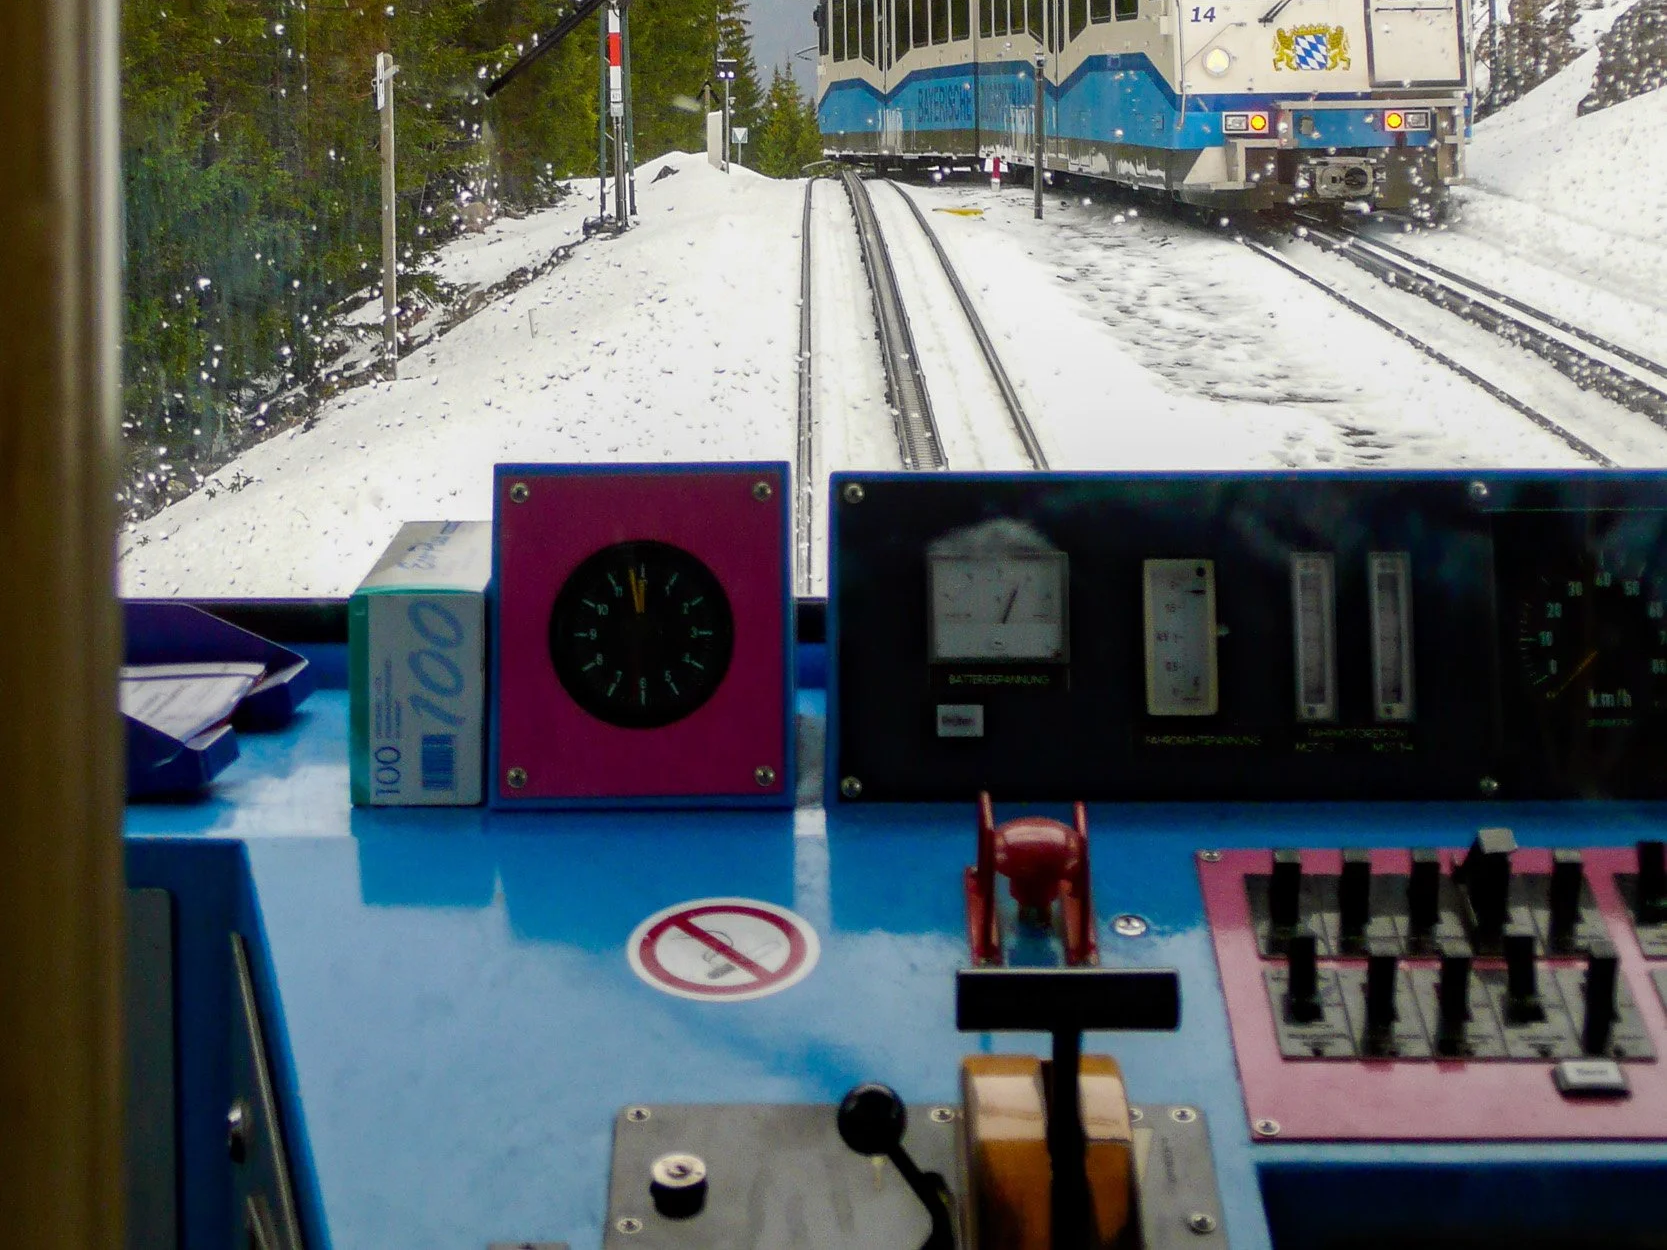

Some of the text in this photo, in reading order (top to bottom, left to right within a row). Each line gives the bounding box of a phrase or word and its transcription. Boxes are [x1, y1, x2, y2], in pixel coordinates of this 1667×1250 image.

[1190, 6, 1217, 23] 14
[407, 599, 466, 727] 100
[374, 745, 402, 797] 100
